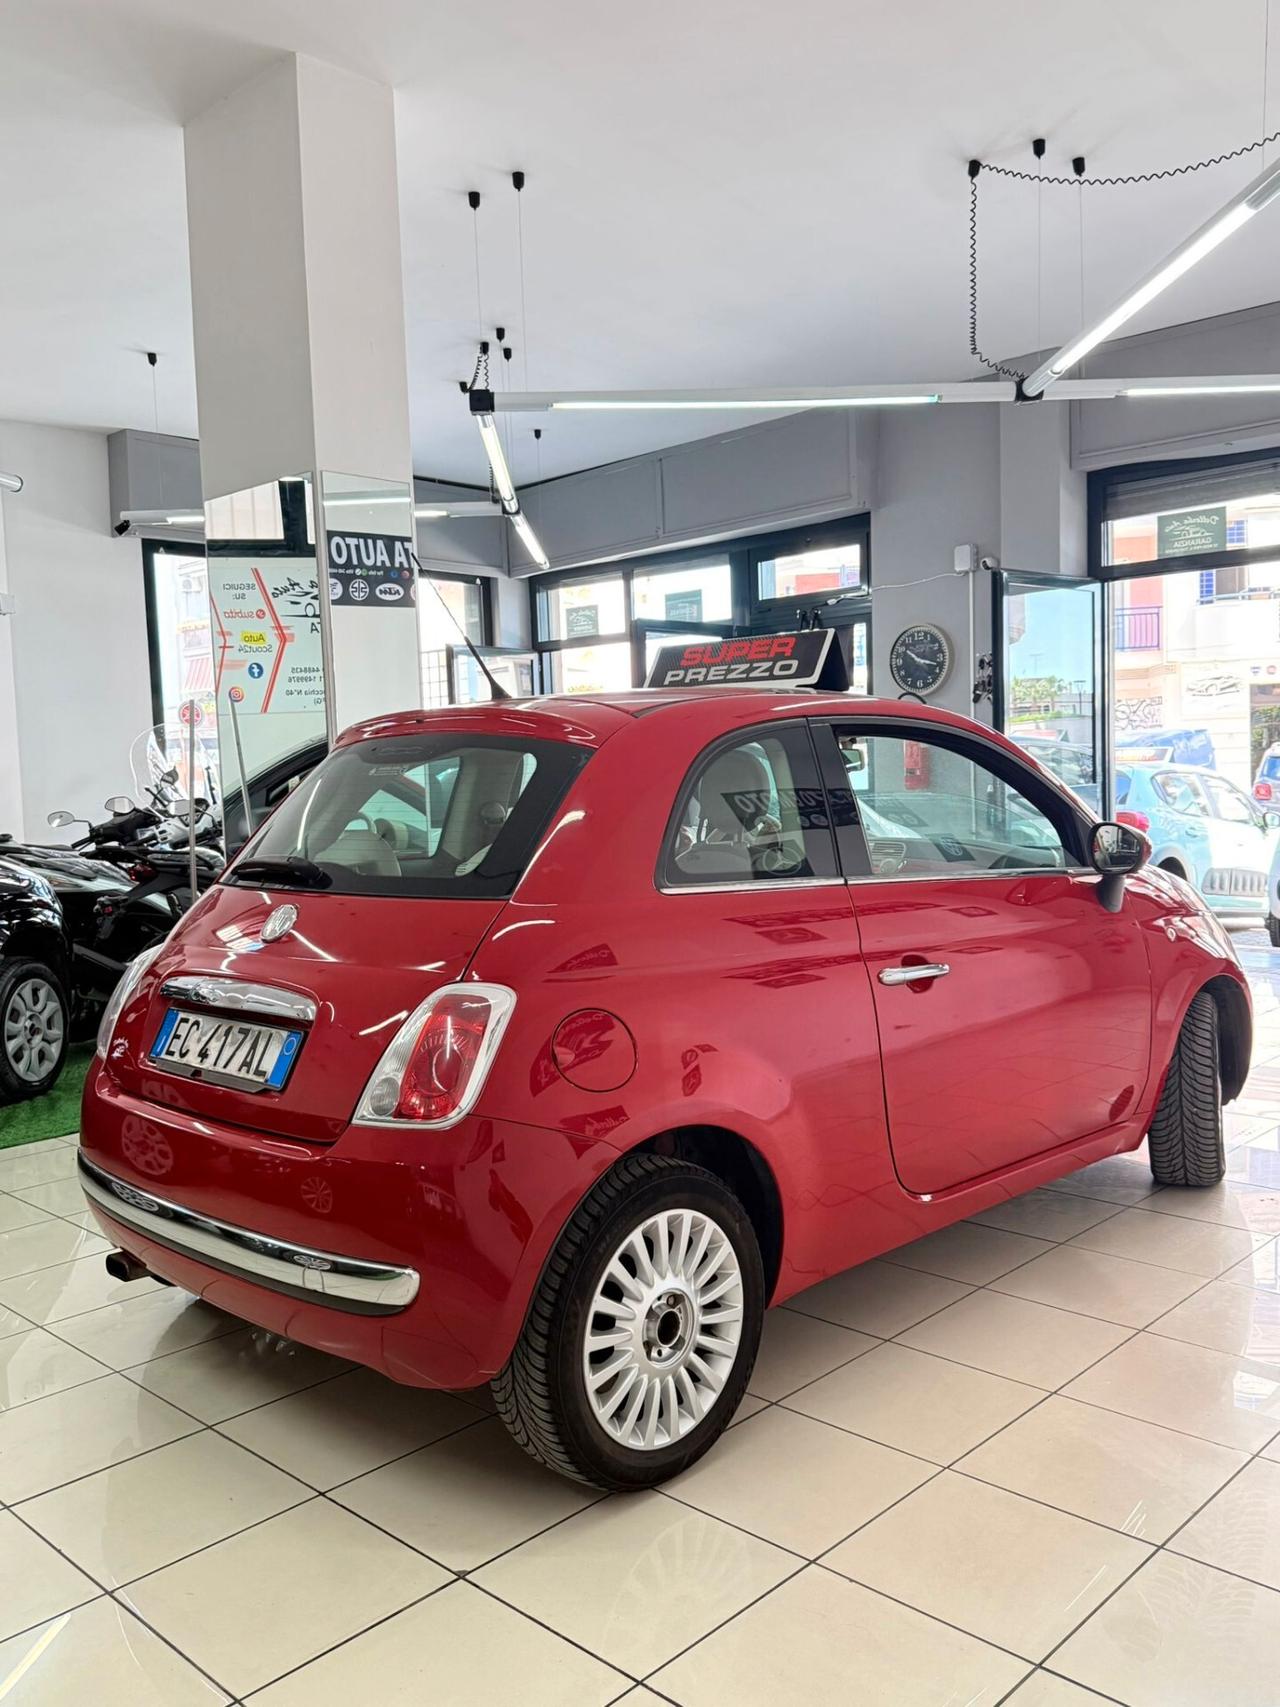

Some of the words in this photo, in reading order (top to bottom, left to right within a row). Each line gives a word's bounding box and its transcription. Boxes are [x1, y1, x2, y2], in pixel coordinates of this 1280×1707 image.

[681, 637, 796, 667] SUPER
[663, 660, 799, 686] PREZZO
[164, 1017, 201, 1058] EC
[197, 1024, 273, 1077] 417AL
